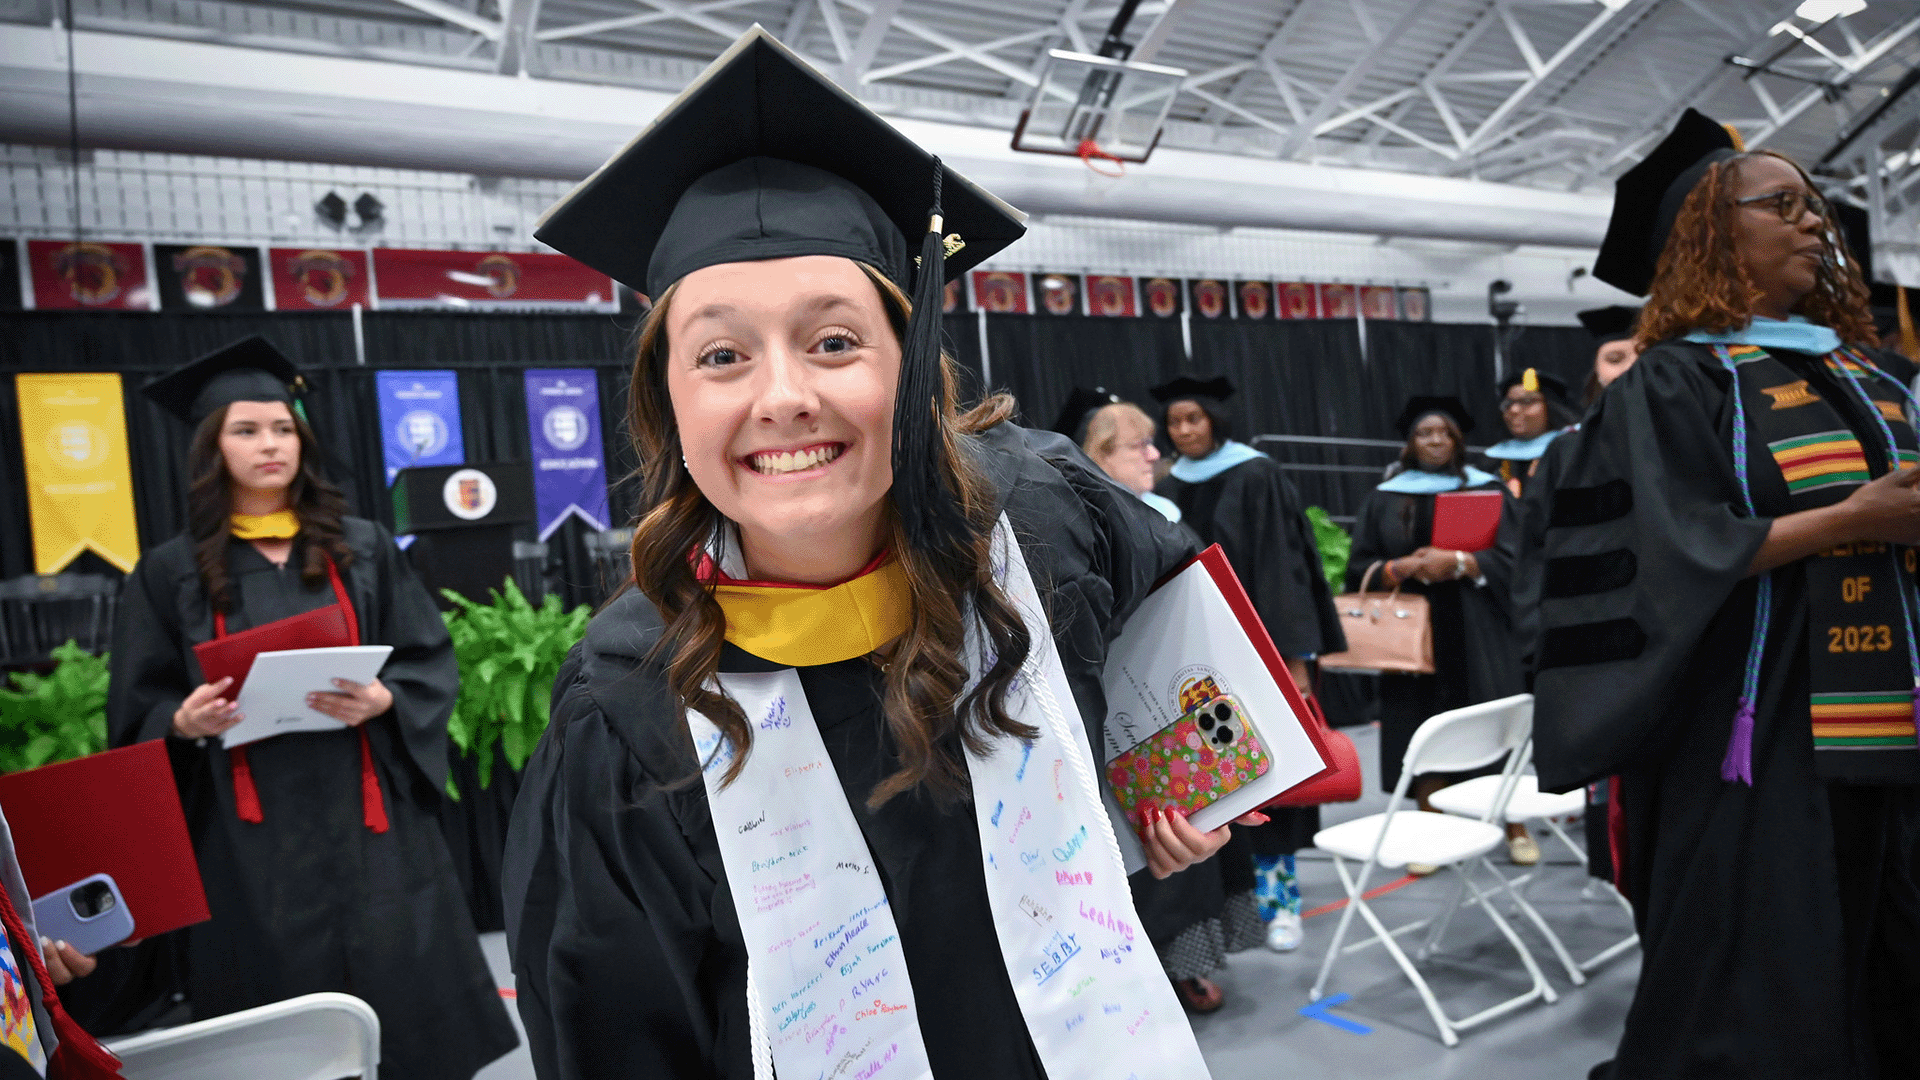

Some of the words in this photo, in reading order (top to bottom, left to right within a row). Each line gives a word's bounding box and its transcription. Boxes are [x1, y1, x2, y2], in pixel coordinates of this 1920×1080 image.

[1841, 576, 1872, 603] OF
[1827, 625, 1892, 653] 2023
[1032, 932, 1077, 981] SEBBY
[855, 1008, 878, 1021] Chloe
